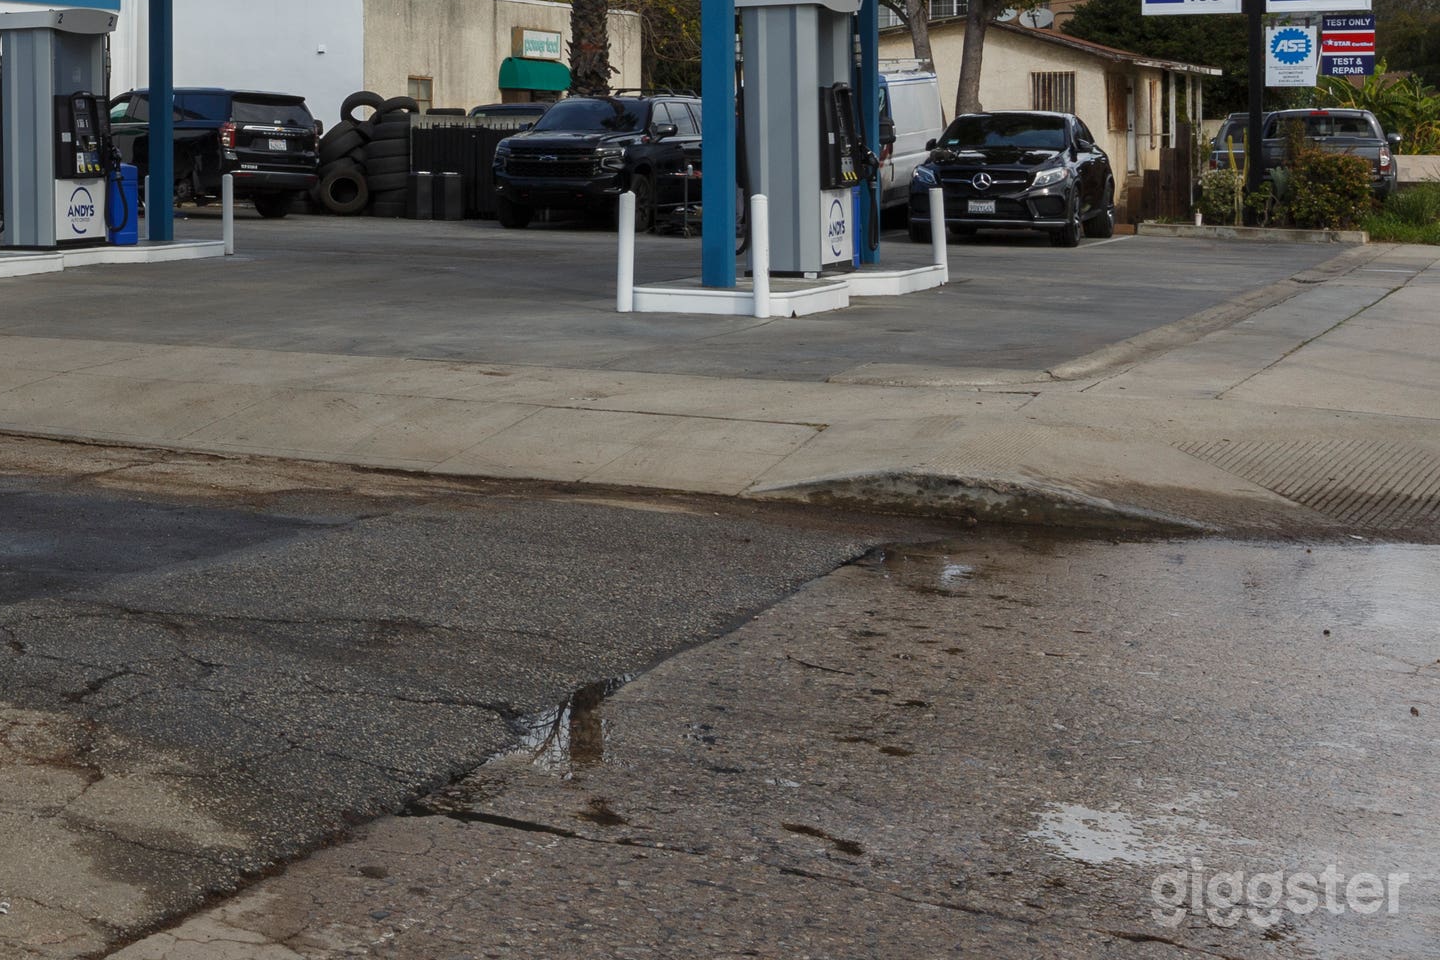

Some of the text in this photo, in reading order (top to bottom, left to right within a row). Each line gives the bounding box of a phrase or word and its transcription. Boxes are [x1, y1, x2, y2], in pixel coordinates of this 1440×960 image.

[1348, 18, 1371, 26] ONLY
[1275, 39, 1306, 52] ASE
[1332, 57, 1362, 65] TEST &
[67, 205, 95, 217] ANDYS
[829, 220, 846, 237] ANDYS
